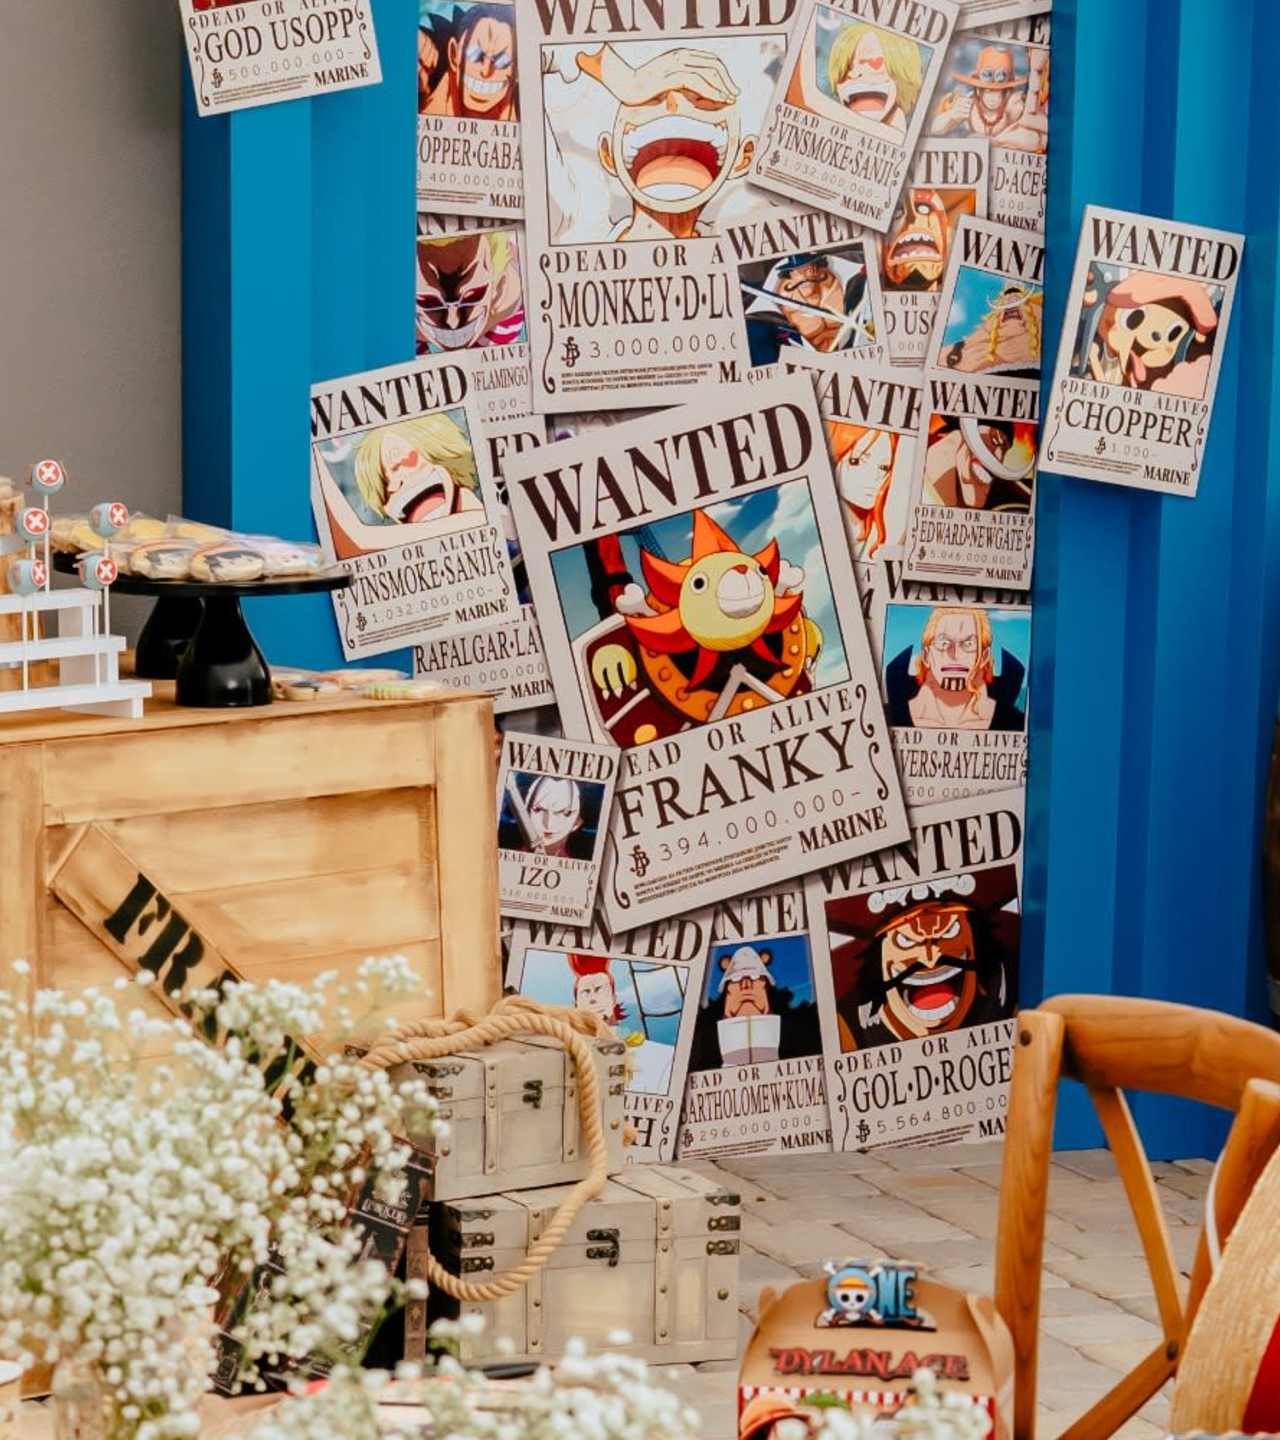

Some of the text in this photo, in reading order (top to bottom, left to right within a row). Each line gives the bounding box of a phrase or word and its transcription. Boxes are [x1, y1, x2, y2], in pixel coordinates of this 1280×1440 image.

[199, 6, 247, 31] DEAD
[261, 0, 285, 17] OR
[204, 8, 356, 64] GOD USOPP
[313, 62, 369, 89] MARINE
[457, 119, 479, 136] OR
[782, 107, 898, 158] DEAD OR ALIVE
[1003, 151, 1043, 168] ALIVE
[841, 195, 884, 221] MARINE
[995, 212, 1039, 232] MARINE
[556, 250, 627, 274] DEAD
[653, 245, 687, 268] OR
[962, 227, 1046, 281] WANT
[1092, 217, 1239, 282] WANTED
[899, 295, 919, 307] OR
[480, 347, 526, 363] ALIVE
[310, 363, 468, 438] WANTED
[930, 379, 1039, 420] WANTE
[1069, 378, 1200, 417] DEAD OR ALIVE
[1065, 398, 1193, 448] CHOPPER
[521, 402, 812, 542] WANTED
[1143, 464, 1192, 486] MARINE
[921, 507, 1025, 527] DEAD OR ALIVE
[401, 529, 488, 565] OR ALIVE
[986, 567, 1024, 582] MARINE
[455, 598, 508, 624] MARINE
[509, 679, 554, 699] MARIN
[625, 688, 852, 777] EAD OR ALIVE
[937, 731, 959, 746] OR
[972, 733, 1021, 748] ALIVE
[508, 741, 614, 782] WANTED
[616, 718, 858, 840] FRANKY
[798, 806, 888, 854] MARINE
[518, 865, 561, 890] IZO
[534, 856, 548, 866] OR
[559, 858, 589, 871] ALIVE
[550, 905, 585, 920] MARINE
[846, 1022, 1015, 1074] DEAD OR ALIV
[690, 1057, 825, 1089] EAD OR ALIVE
[624, 1097, 665, 1115] LIVE
[780, 1127, 834, 1151] MARINE
[769, 1346, 970, 1381] DYLAN ACE
